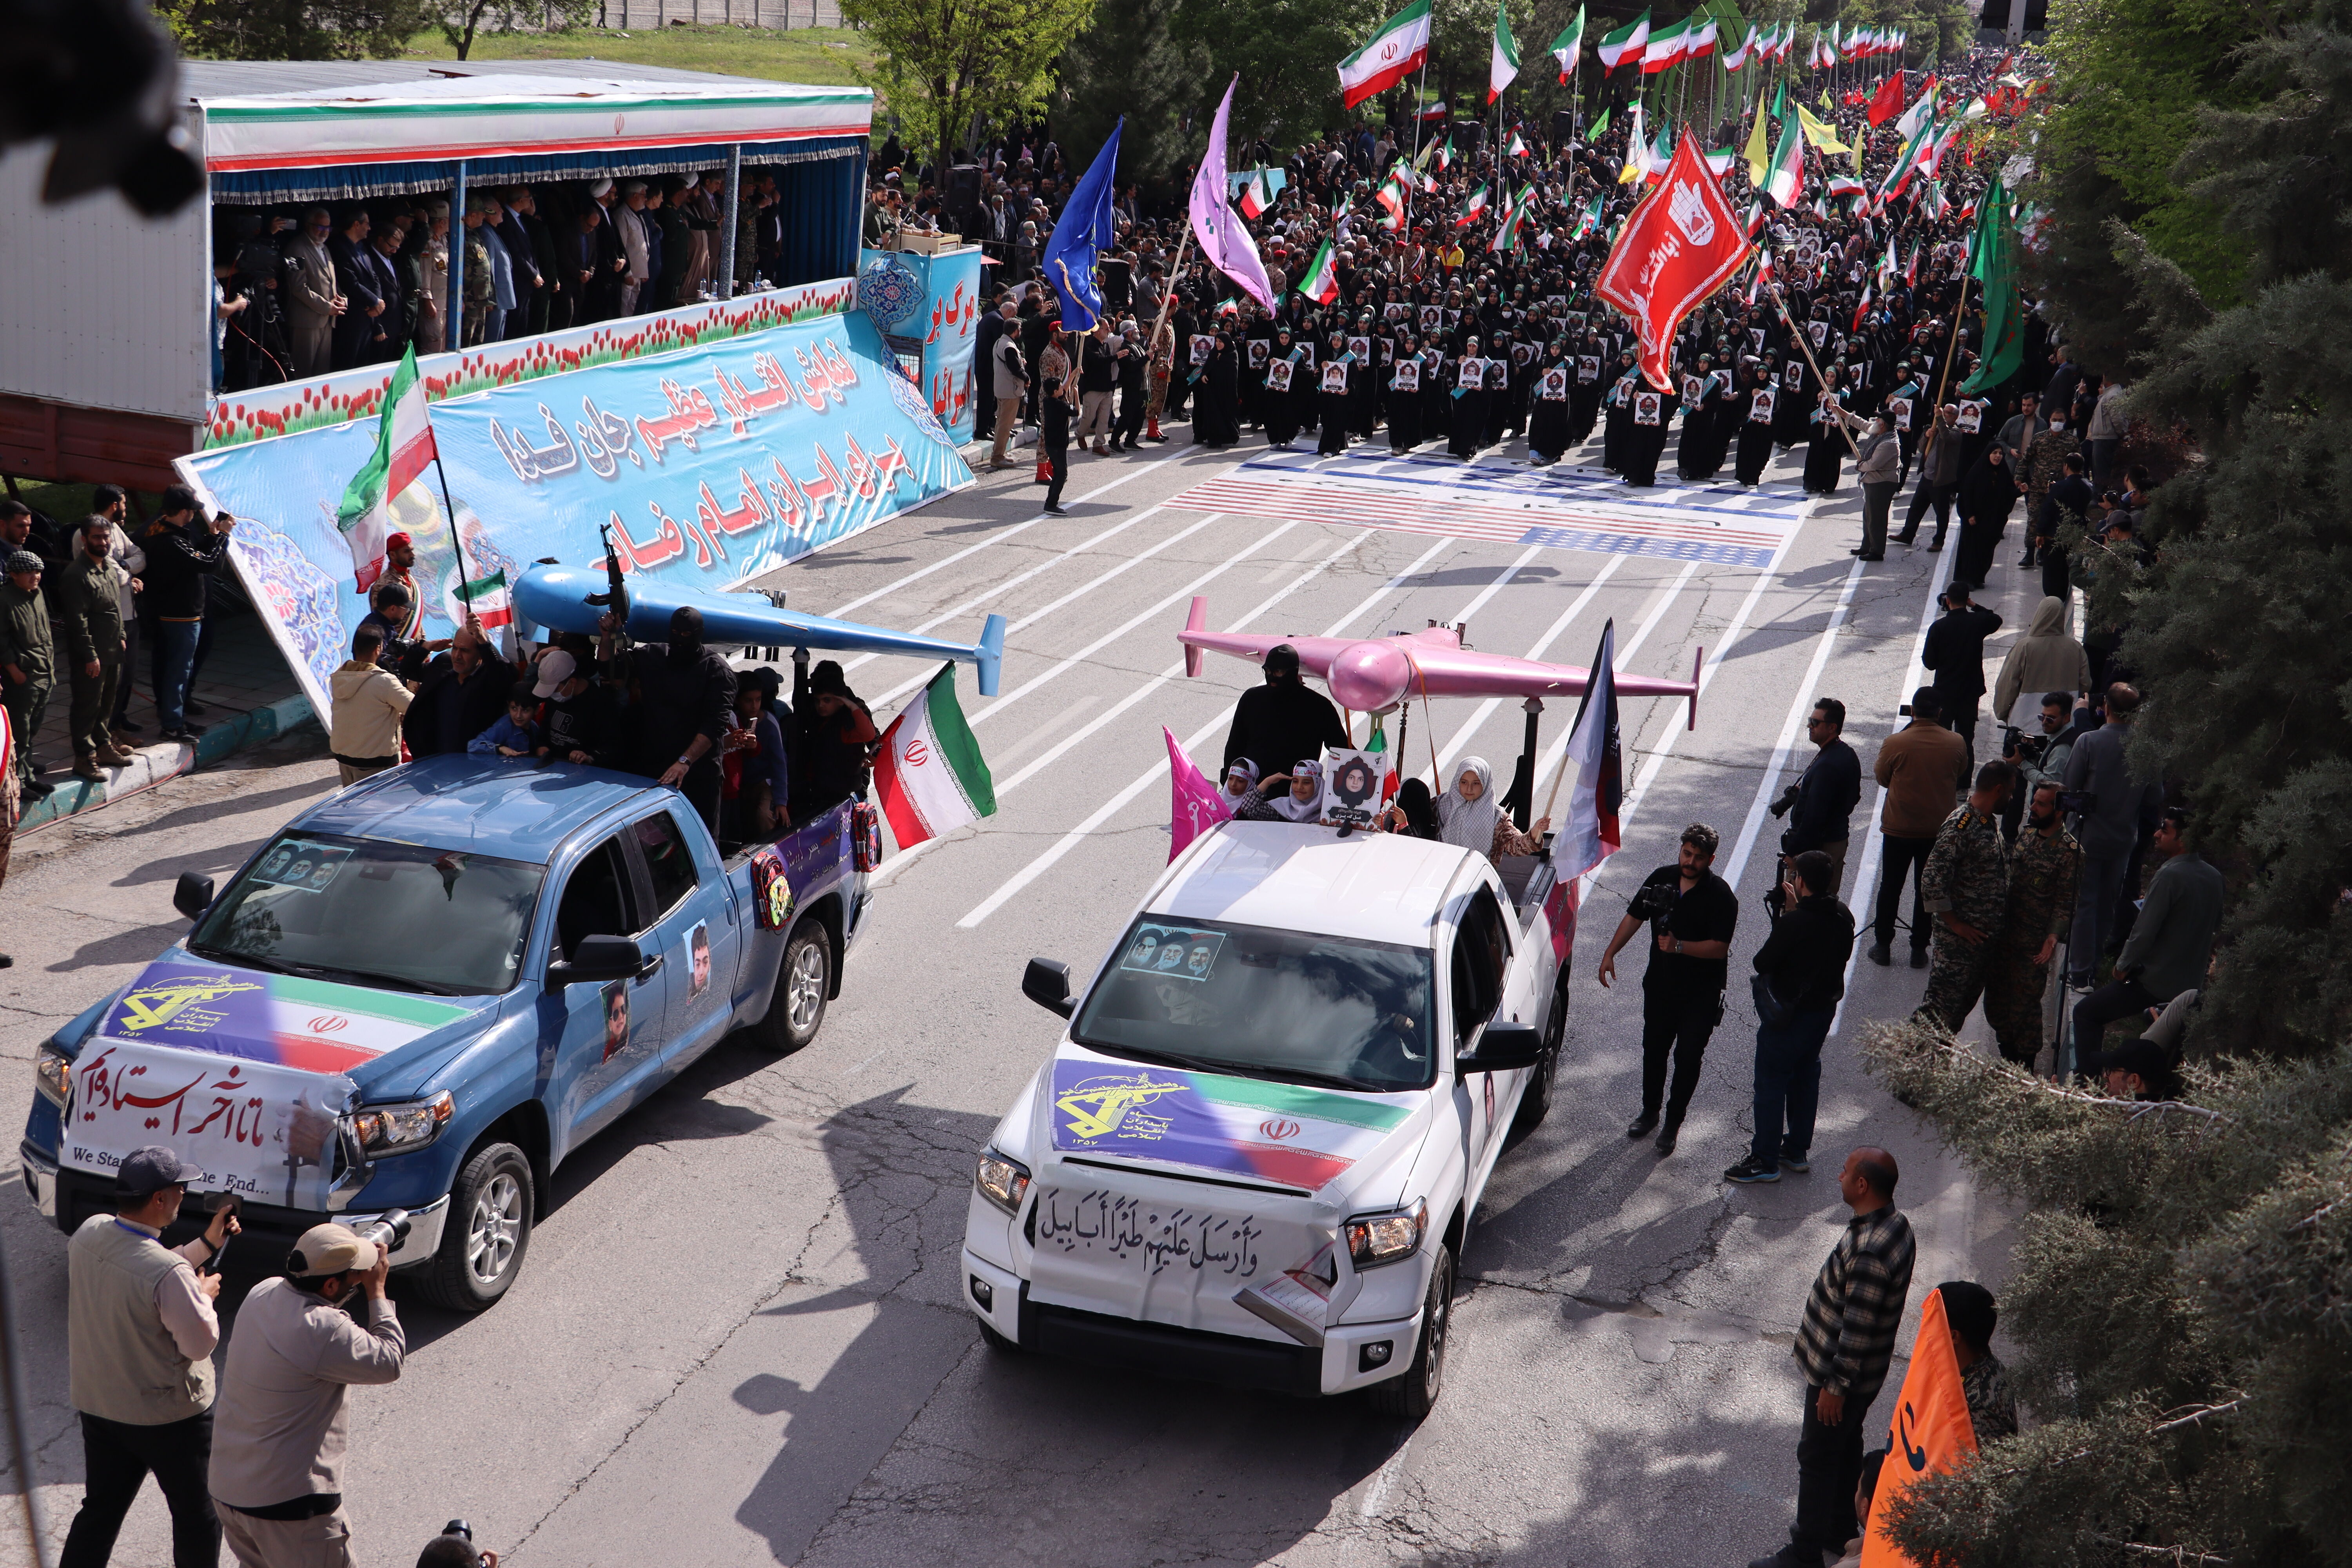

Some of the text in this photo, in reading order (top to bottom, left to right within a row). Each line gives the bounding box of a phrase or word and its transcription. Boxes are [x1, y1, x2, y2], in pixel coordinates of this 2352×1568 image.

[926, 279, 975, 345] مرگ بر
[490, 337, 857, 481] نمایش اقتدار عظیم جان فدا
[843, 432, 915, 499] برای
[771, 441, 848, 529] ایران
[696, 467, 773, 560] امام
[189, 1006, 230, 1016] سپاه
[173, 1018, 216, 1027] انقلاب
[180, 1012, 222, 1022] پاسداران
[77, 1047, 264, 1147] تا آخر ایستاده ایم
[1130, 1111, 1174, 1121] سپاه
[1125, 1118, 1169, 1129] پاسداران
[1122, 1125, 1166, 1134] انقلاب
[1072, 1138, 1098, 1146] ۱۳۵۷
[1117, 1132, 1162, 1141] اسلامی
[73, 1147, 93, 1163] We
[202, 1167, 216, 1183] he
